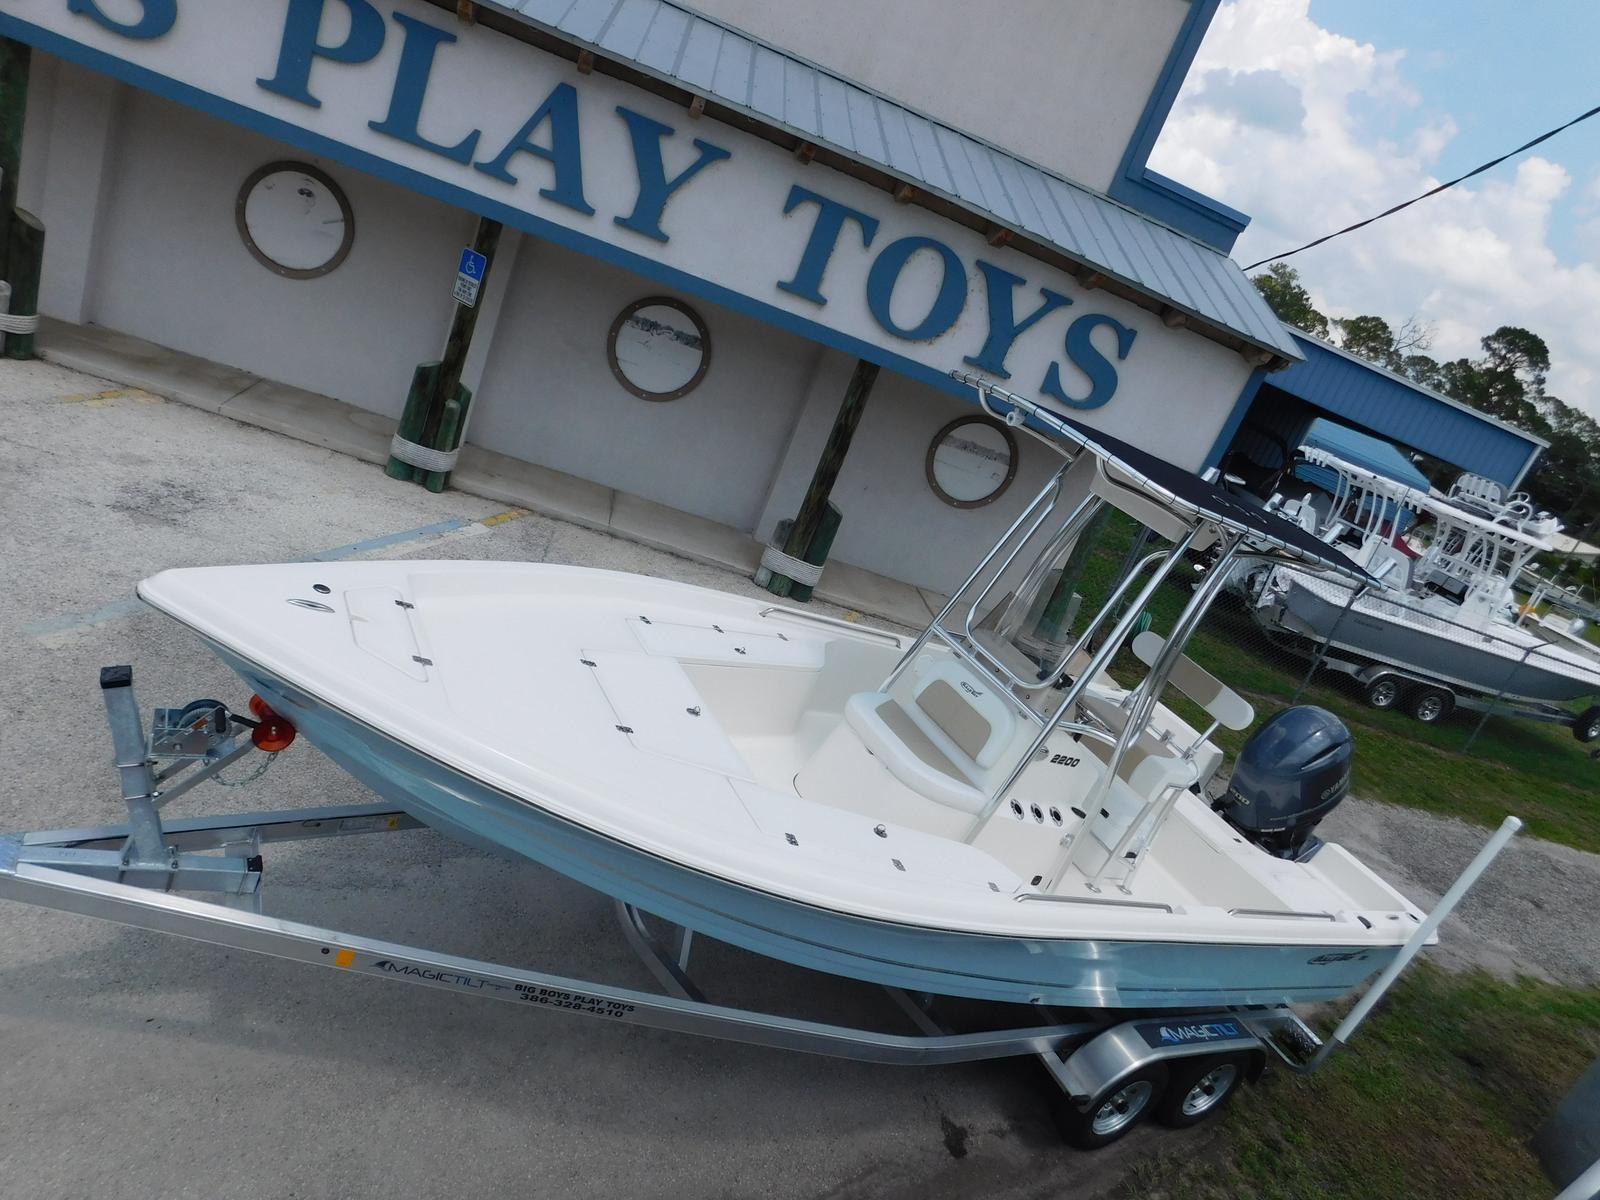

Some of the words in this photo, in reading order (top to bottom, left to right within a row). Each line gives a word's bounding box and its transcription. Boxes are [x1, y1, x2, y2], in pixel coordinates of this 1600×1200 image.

[256, 0, 731, 242] PLAY
[776, 185, 1138, 410] TOYS
[1050, 754, 1080, 768] 2200
[387, 961, 489, 989] MAGICTILT
[514, 984, 536, 994] BIG
[539, 988, 570, 1000] BOYS
[574, 994, 603, 1006] PLAY
[607, 1001, 640, 1012] TOYS
[520, 993, 624, 1017] 386-328-4510
